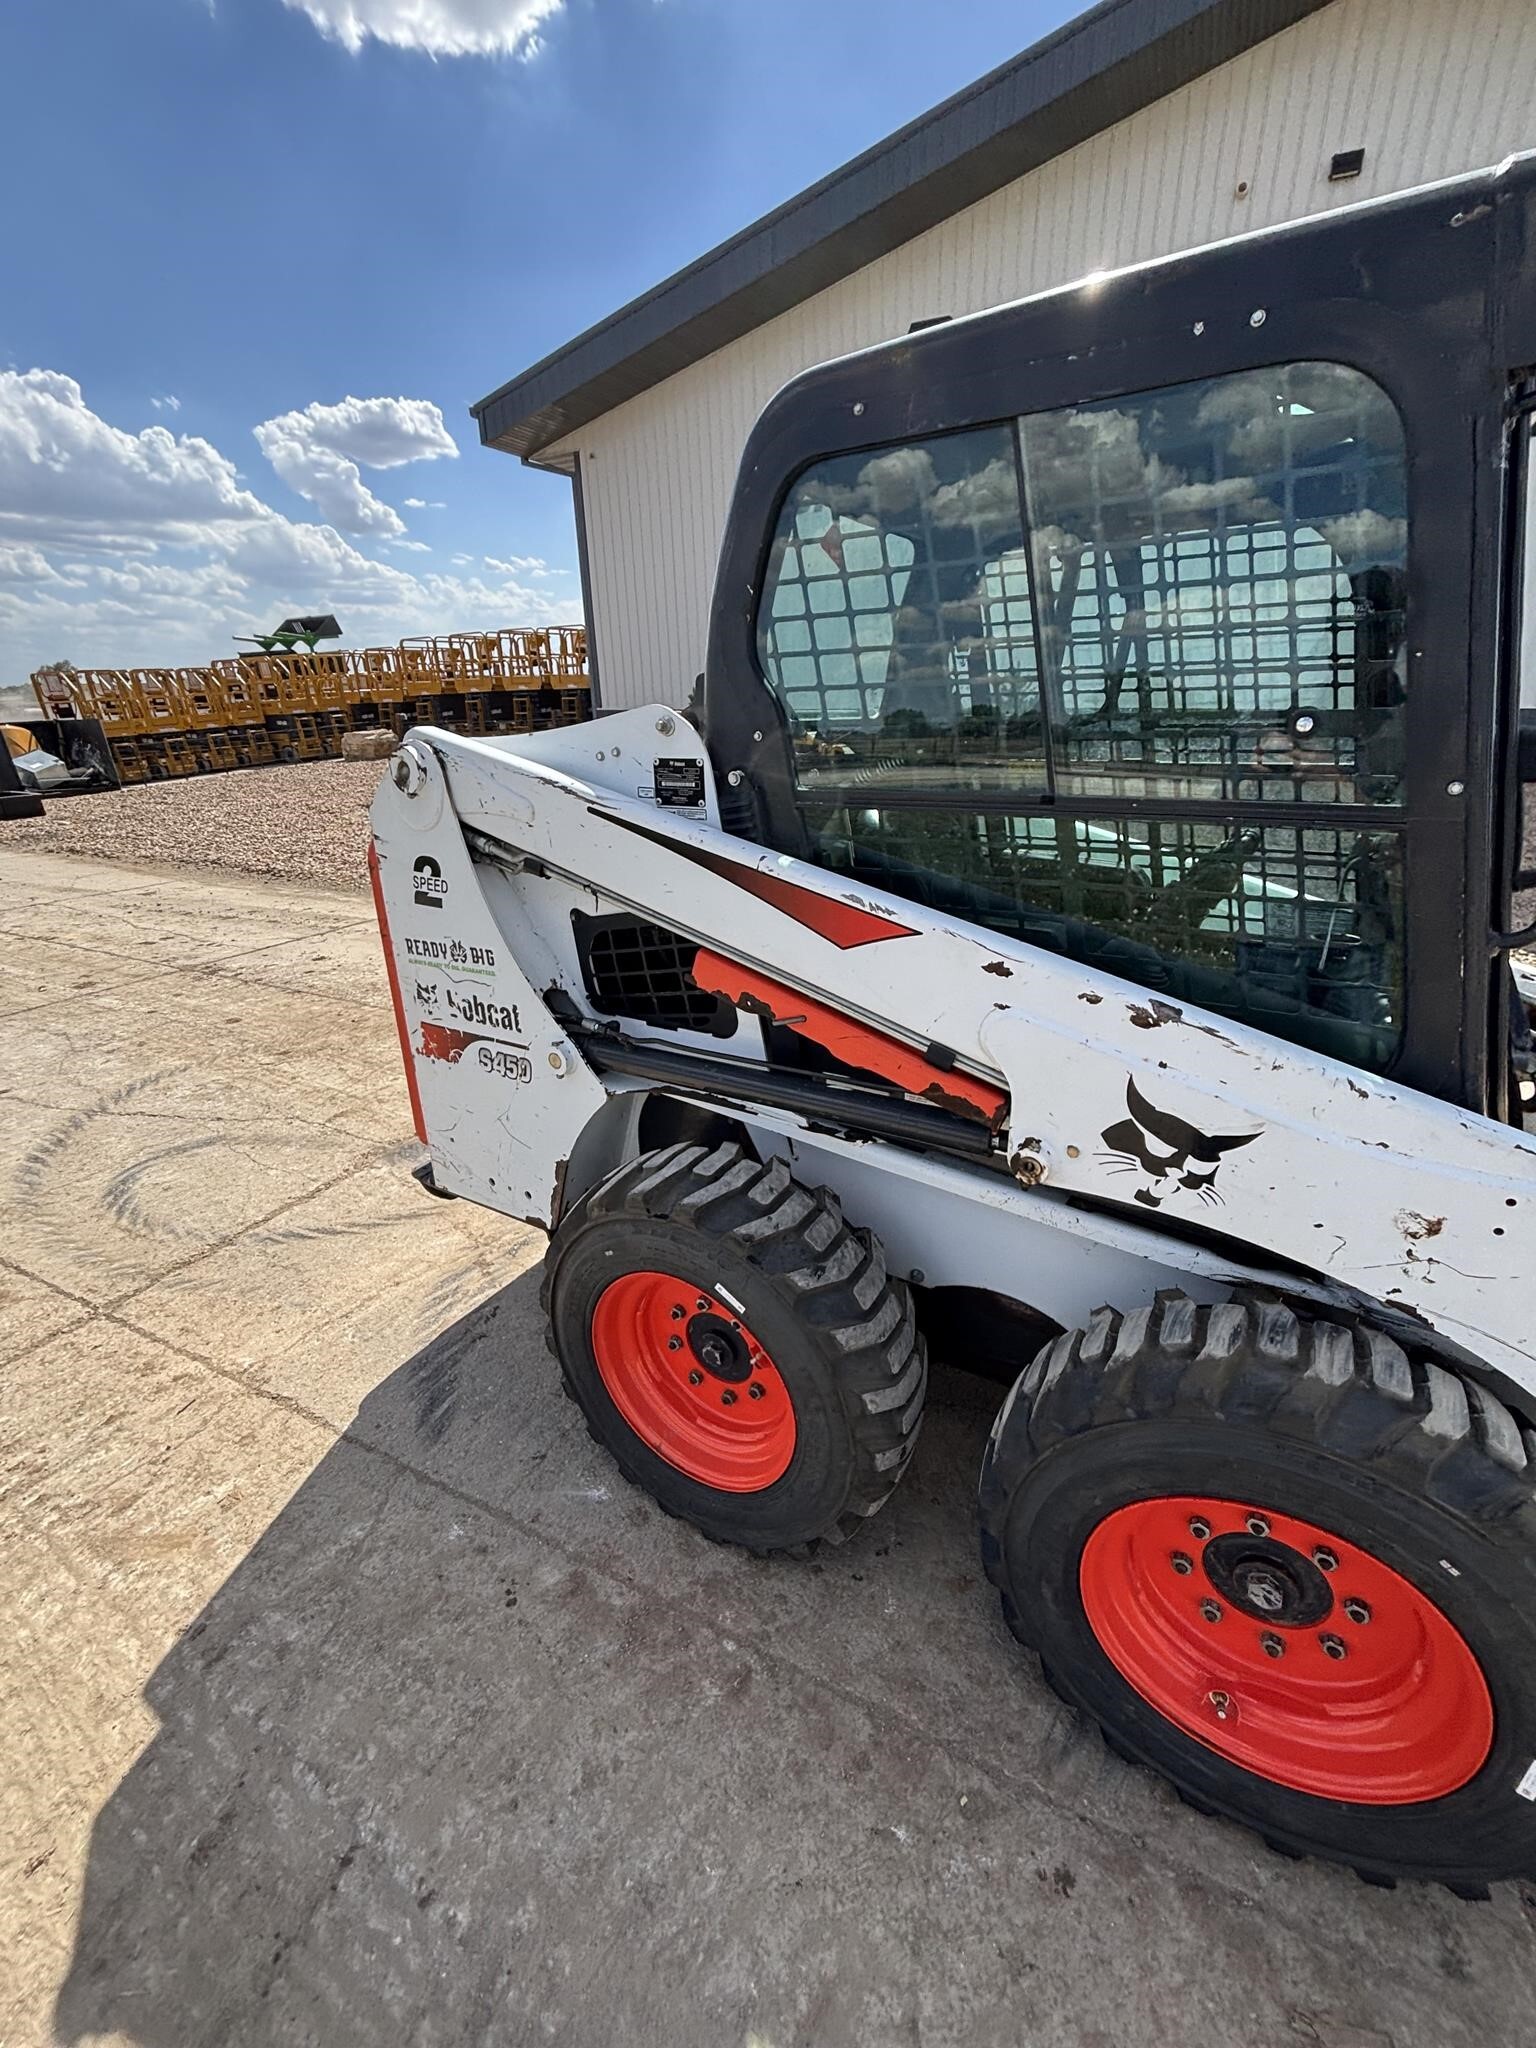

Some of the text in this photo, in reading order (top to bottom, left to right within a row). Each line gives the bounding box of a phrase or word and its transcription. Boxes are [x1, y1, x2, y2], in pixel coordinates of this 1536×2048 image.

[412, 875, 449, 894] SPEED
[413, 855, 443, 909] 2
[405, 937, 496, 967] READY DIG
[478, 1047, 533, 1084] S450
